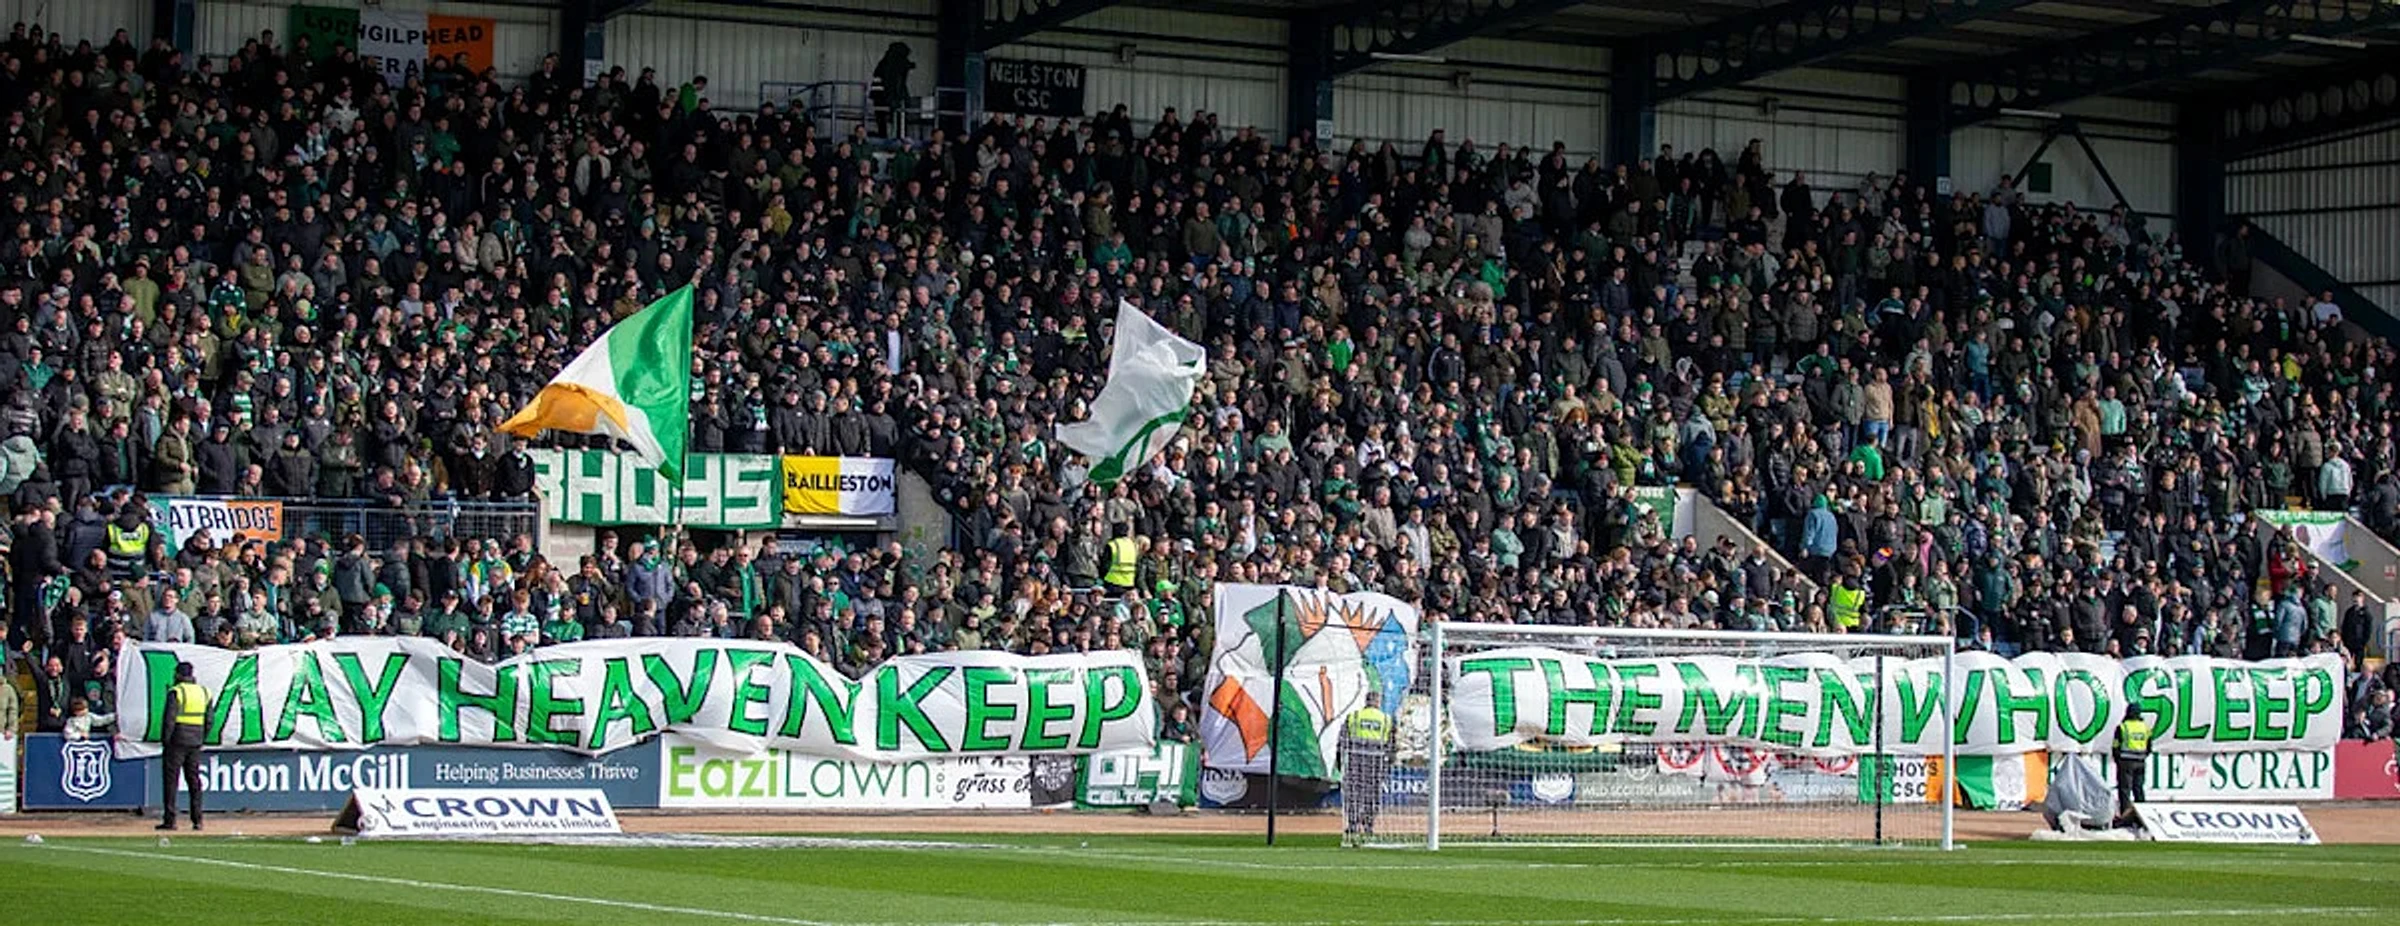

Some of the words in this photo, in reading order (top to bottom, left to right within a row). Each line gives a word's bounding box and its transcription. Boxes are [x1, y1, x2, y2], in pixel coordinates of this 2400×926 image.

[304, 11, 484, 45] LOCHGILPHEAD
[990, 62, 1079, 88] NEILSTON
[1013, 88, 1051, 109] CSC
[788, 471, 892, 492] BAILLIESTON
[141, 650, 411, 745] MAY
[437, 648, 863, 749] HEAVEN
[876, 664, 1143, 751] KEEP
[1460, 658, 1663, 737] THE
[1673, 661, 1876, 746] MEN
[1895, 666, 2110, 744] WHO
[2122, 666, 2334, 742] SLEEP
[178, 755, 289, 792] shton
[299, 753, 409, 791] McGill
[435, 763, 498, 784] Helping
[503, 762, 585, 780] Businesses
[588, 762, 639, 780] Thrive
[669, 746, 930, 798] EaziLawn
[2210, 750, 2330, 790] SCRAP
[953, 778, 1006, 802] grass
[1086, 788, 1151, 804] CELTIC
[1891, 783, 1927, 797] CSC
[403, 797, 604, 818] CROWN
[413, 818, 497, 830] engineering
[502, 819, 557, 829] services
[561, 817, 613, 829] limited
[2170, 811, 2302, 829] CROWN
